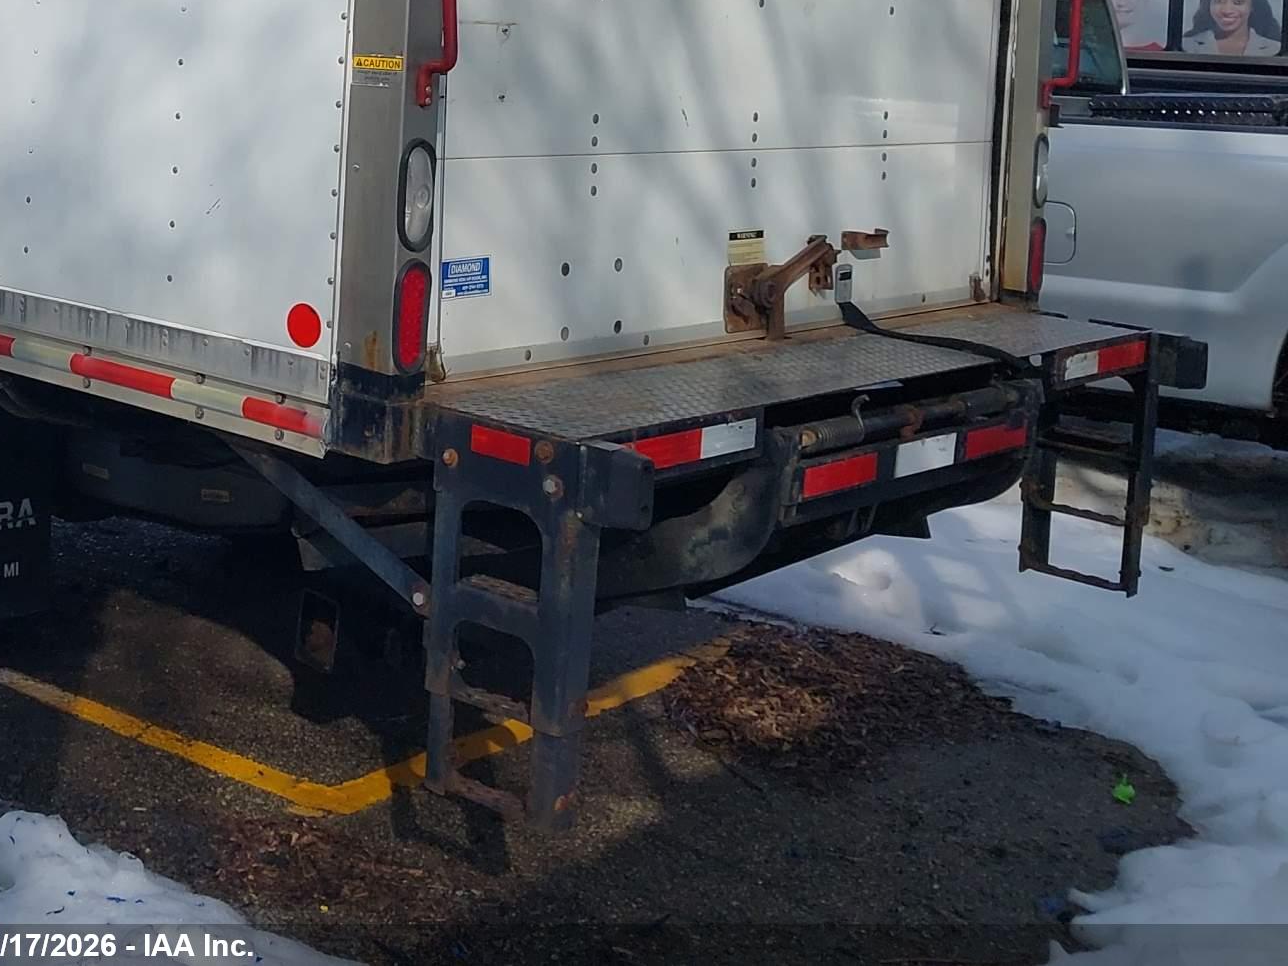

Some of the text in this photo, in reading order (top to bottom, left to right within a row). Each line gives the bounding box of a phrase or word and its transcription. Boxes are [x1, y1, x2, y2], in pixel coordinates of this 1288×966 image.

[363, 58, 401, 69] CAUTION
[451, 262, 481, 274] DIAMOND
[4, 562, 19, 579] MI
